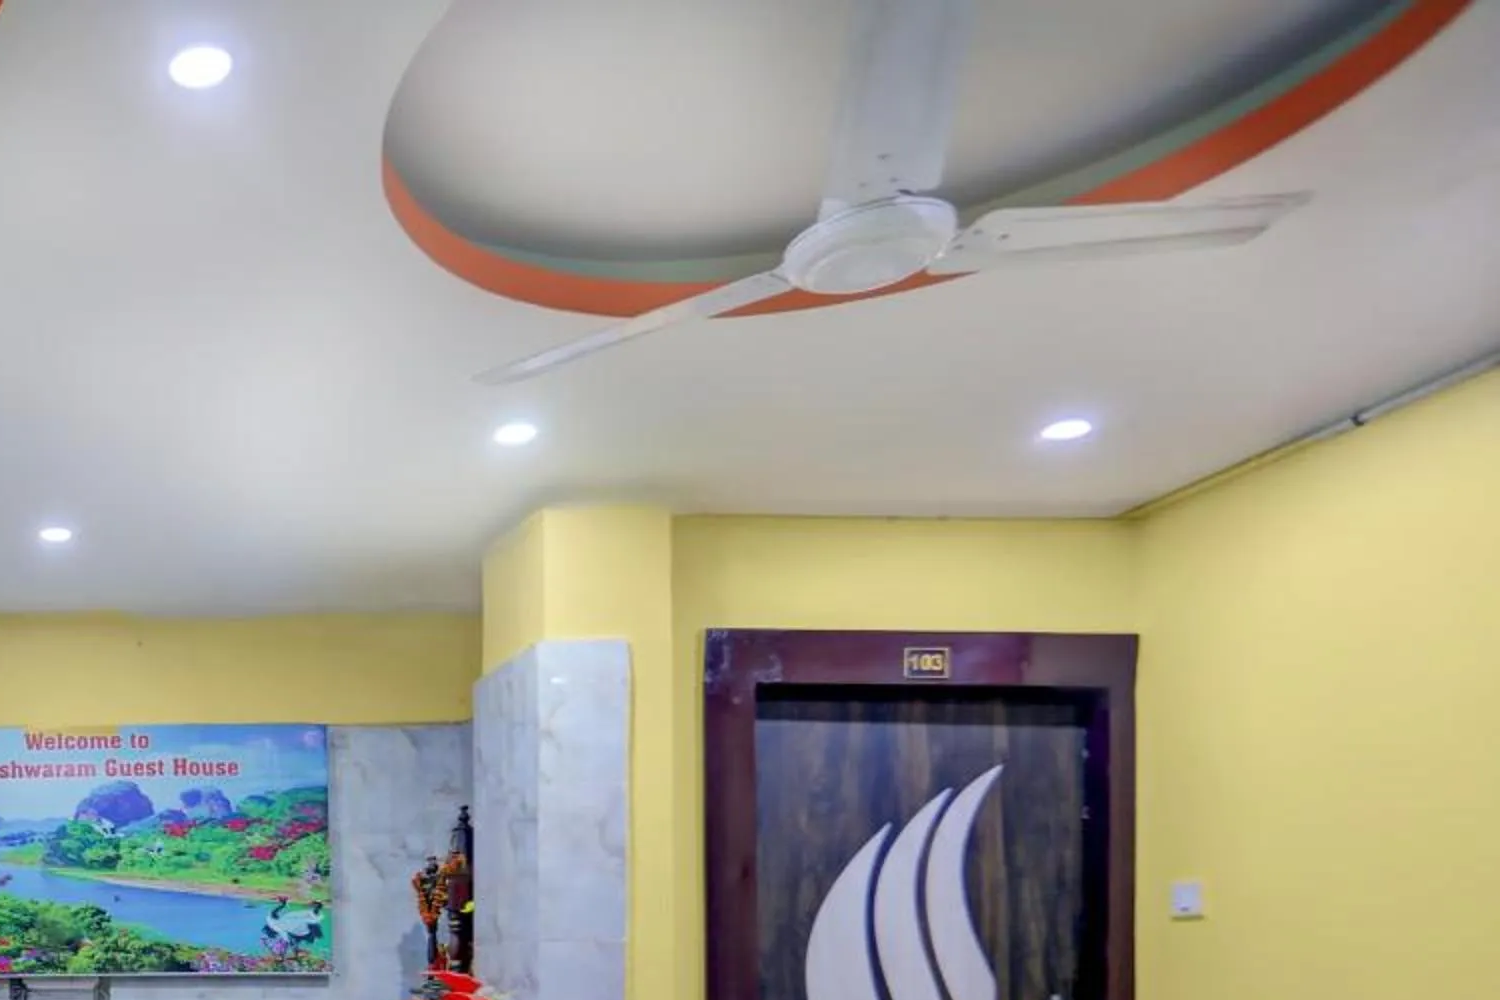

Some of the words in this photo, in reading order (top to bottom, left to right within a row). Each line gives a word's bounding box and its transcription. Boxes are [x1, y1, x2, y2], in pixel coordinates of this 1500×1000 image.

[909, 654, 943, 671] 103
[24, 732, 121, 750] Welcome
[131, 733, 149, 749] to
[105, 759, 165, 777] Guest
[173, 758, 239, 777] House
